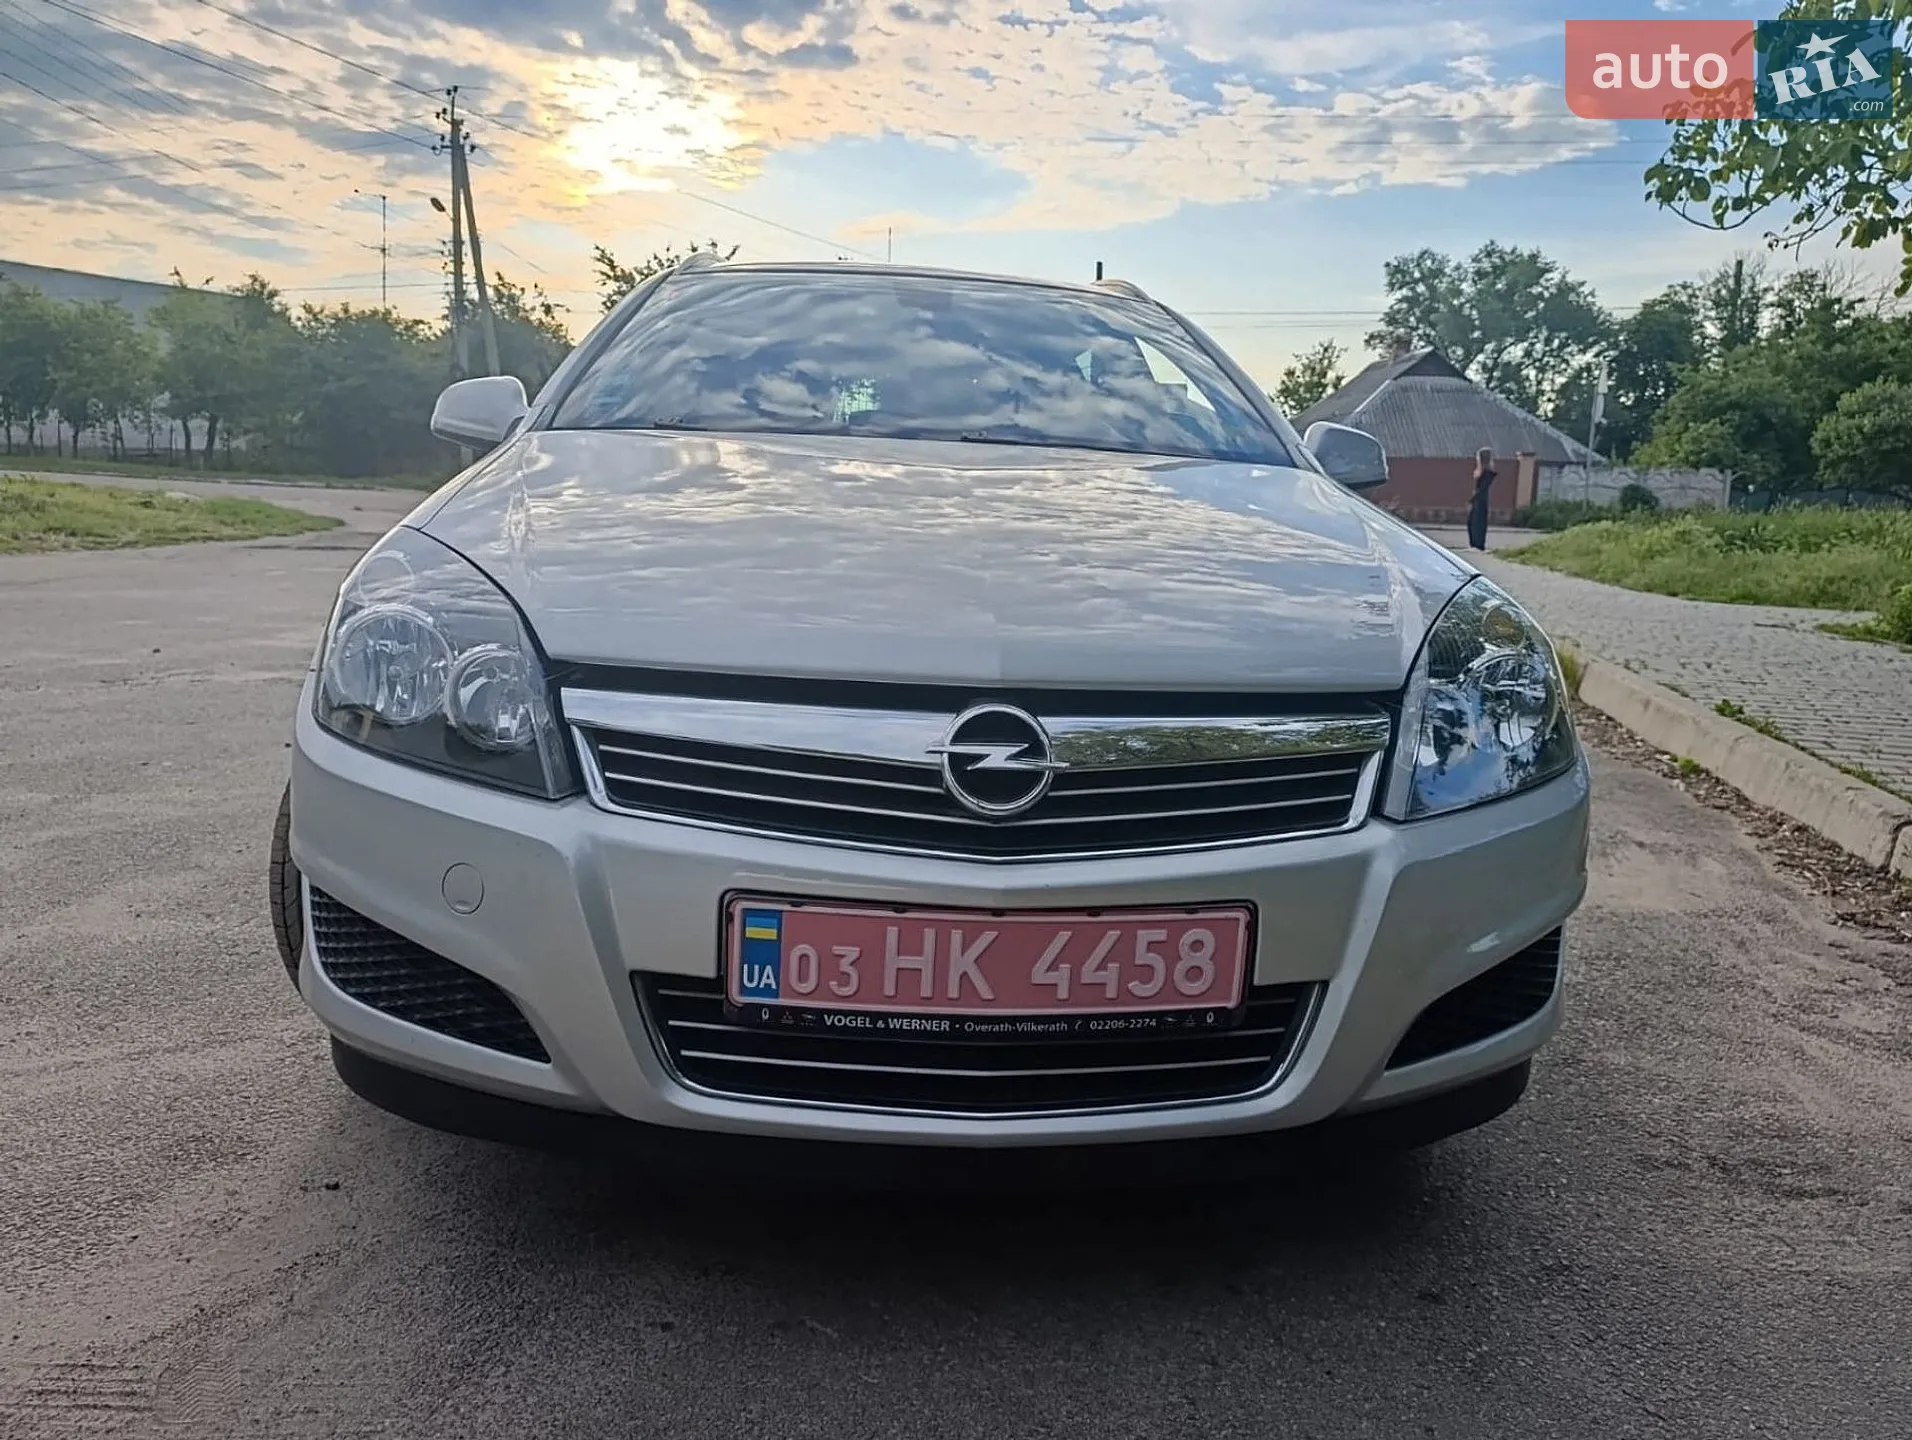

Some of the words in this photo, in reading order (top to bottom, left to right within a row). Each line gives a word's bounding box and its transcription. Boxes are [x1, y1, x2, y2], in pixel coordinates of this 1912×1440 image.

[742, 962, 777, 991] UA
[788, 944, 863, 996] 03
[883, 926, 998, 999] HK
[1030, 928, 1217, 1001] 4458
[823, 1014, 874, 1029] VOGEL
[876, 1018, 885, 1029] &
[888, 1018, 950, 1032] WERNER
[964, 1020, 1068, 1033] Overath-Vilkerath
[1089, 1018, 1157, 1031] 02206-2274
